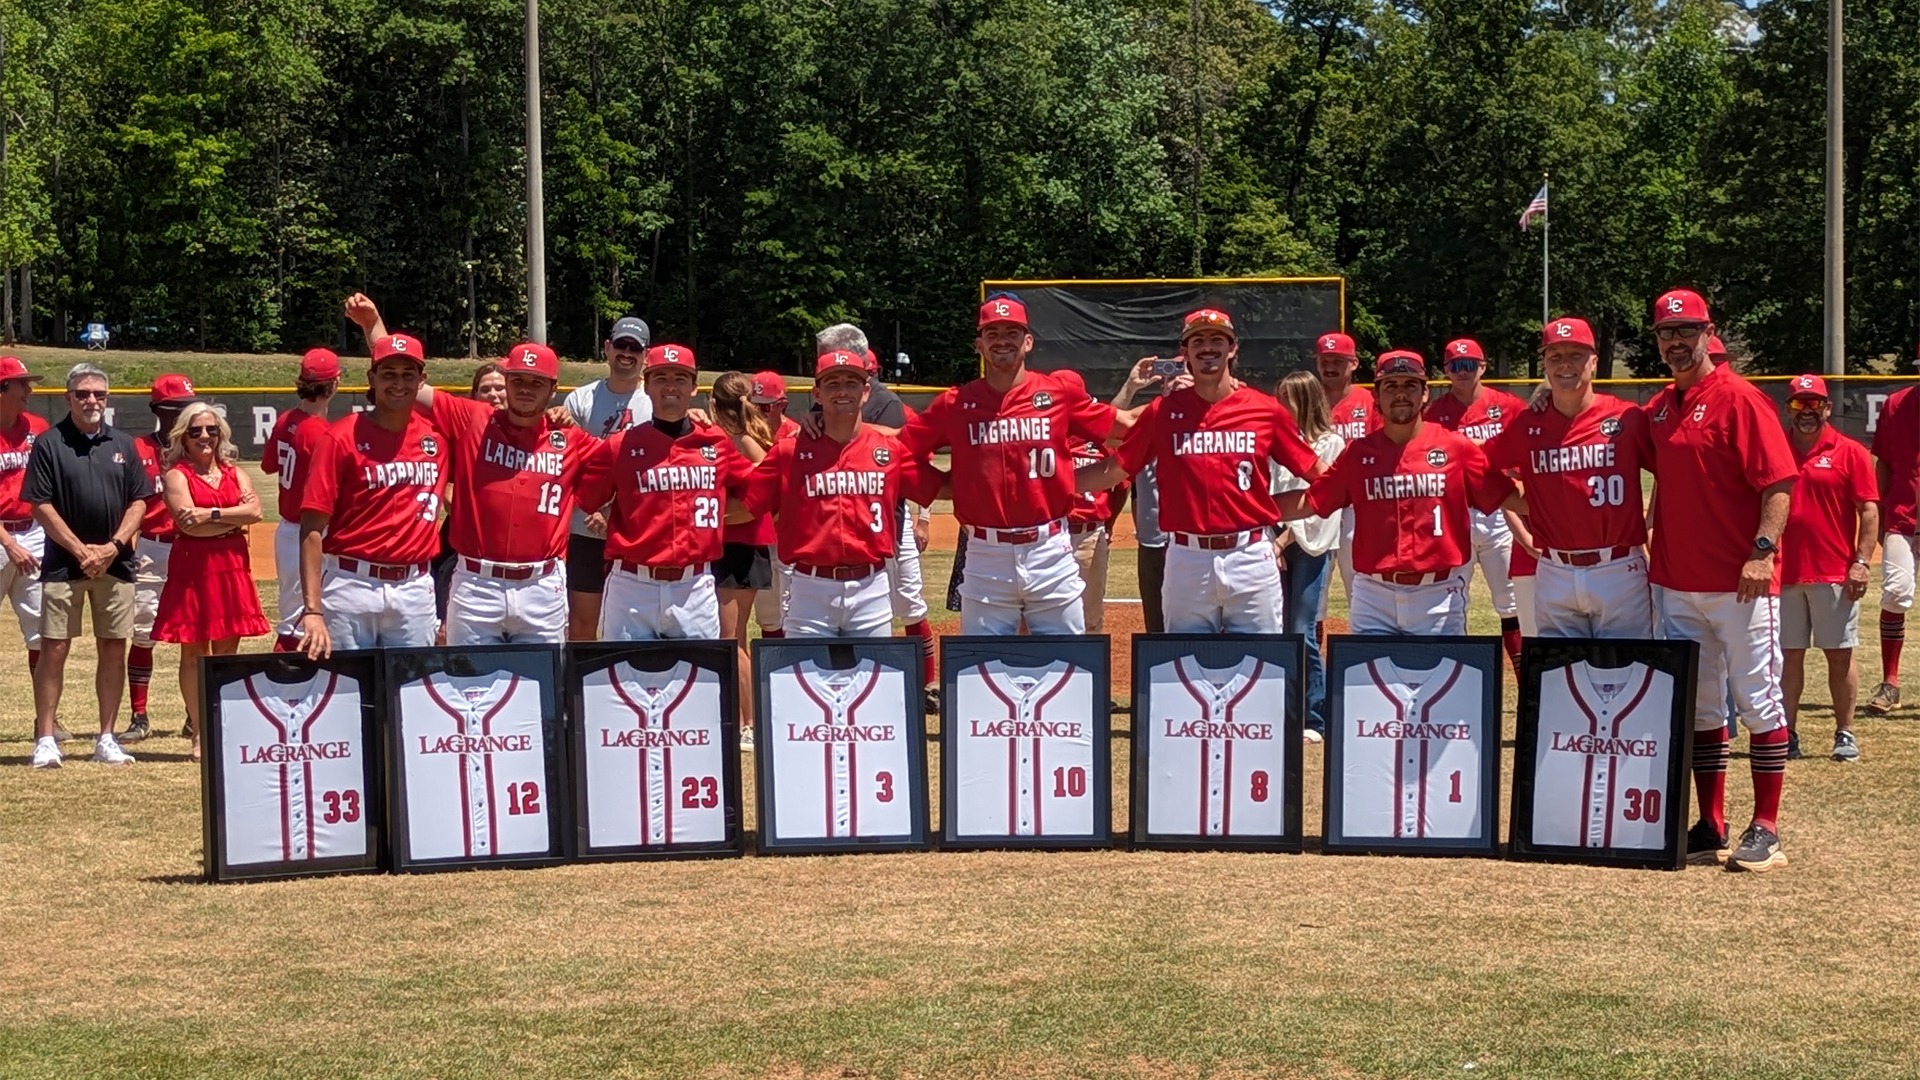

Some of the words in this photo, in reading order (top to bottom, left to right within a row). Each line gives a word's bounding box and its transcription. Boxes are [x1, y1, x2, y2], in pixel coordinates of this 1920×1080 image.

[995, 302, 1010, 317] LC
[1667, 296, 1683, 313] LC
[391, 336, 407, 351] LC
[1324, 337, 1336, 349] LC
[1557, 322, 1572, 337] LC
[523, 349, 538, 367] LC
[664, 347, 679, 362] LC
[1456, 342, 1468, 354] LC
[754, 381, 764, 395] LC
[1800, 377, 1813, 389] LC
[969, 417, 1051, 446] LAGRANGE
[1173, 431, 1256, 456] LAGRANGE
[485, 437, 564, 477] LAGRANGE
[1028, 447, 1056, 479] 10
[1530, 442, 1615, 475] LAGRANGE
[365, 461, 438, 490] LAGRANGE
[636, 466, 716, 494] LAGRANGE
[805, 471, 886, 497] LAGRANGE
[1237, 460, 1253, 491] 8
[1364, 473, 1446, 501] LAGRANGE
[537, 481, 563, 517] 12
[1587, 474, 1624, 507] 30
[694, 496, 719, 529] 23
[869, 501, 883, 533] 3
[1432, 504, 1443, 537] 1
[601, 728, 710, 748] LAGRANGE
[787, 723, 896, 742] LAGRANGE
[970, 719, 1082, 738] LAGRANGE
[1164, 718, 1273, 740] LAGRANGE
[1356, 719, 1471, 740] LAGRANGE
[240, 741, 351, 764] LAGRANGE
[419, 734, 532, 755] LAGRANGE
[1551, 731, 1657, 757] LAGRANGE
[681, 776, 719, 809] 23
[875, 771, 894, 803] 3
[1053, 766, 1086, 798] 10
[1250, 769, 1269, 802] 8
[1449, 770, 1462, 803] 1
[323, 789, 360, 824] 33
[507, 781, 540, 816] 12
[1623, 787, 1662, 824] 30
